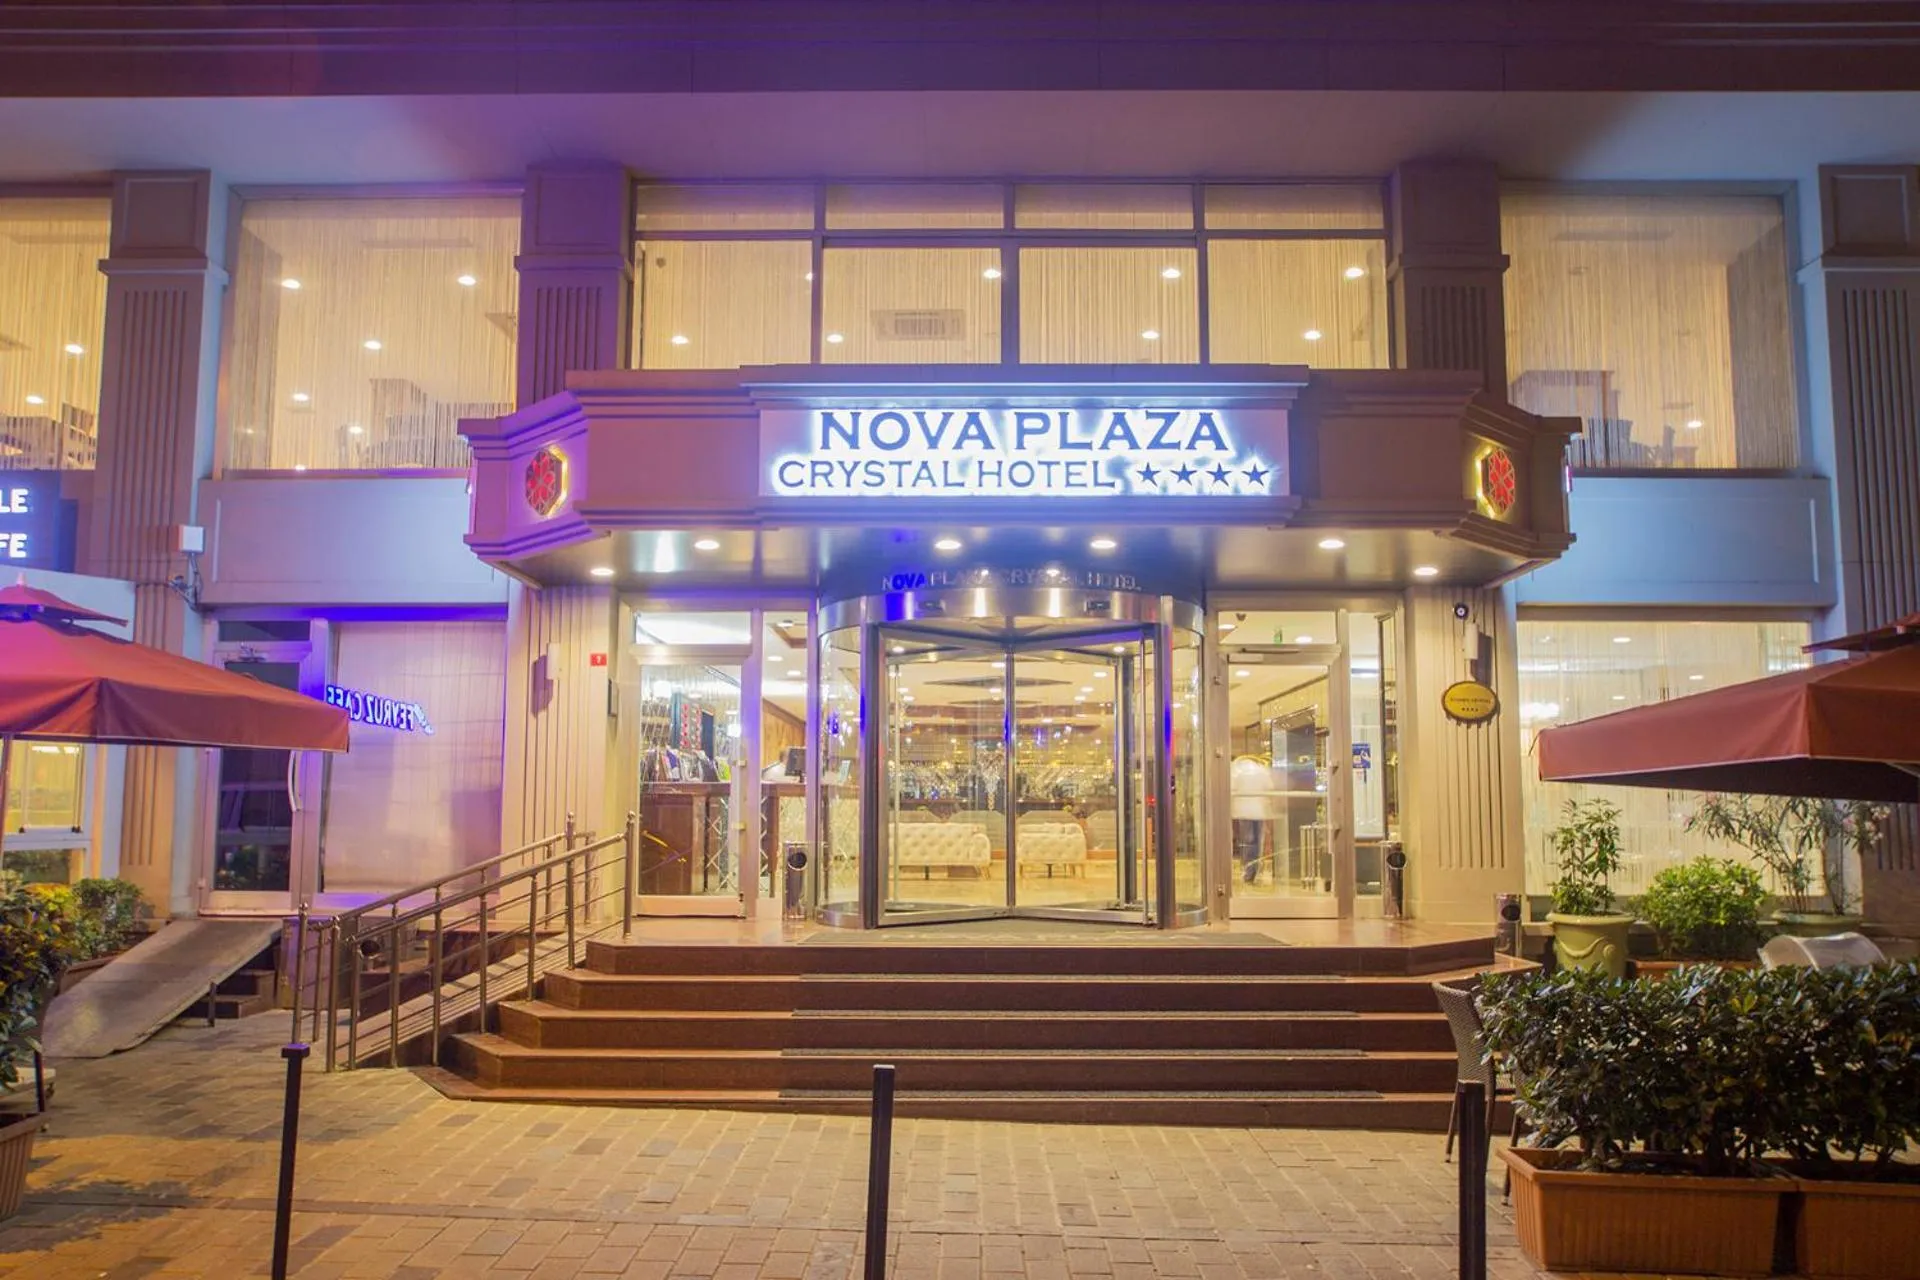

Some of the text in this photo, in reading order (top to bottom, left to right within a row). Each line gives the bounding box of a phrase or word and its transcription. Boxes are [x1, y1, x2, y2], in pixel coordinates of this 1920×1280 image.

[820, 411, 1229, 450] NOVA PLAZA
[778, 460, 1116, 488] CRYSTAL HOTEL
[881, 572, 926, 591] NOVA
